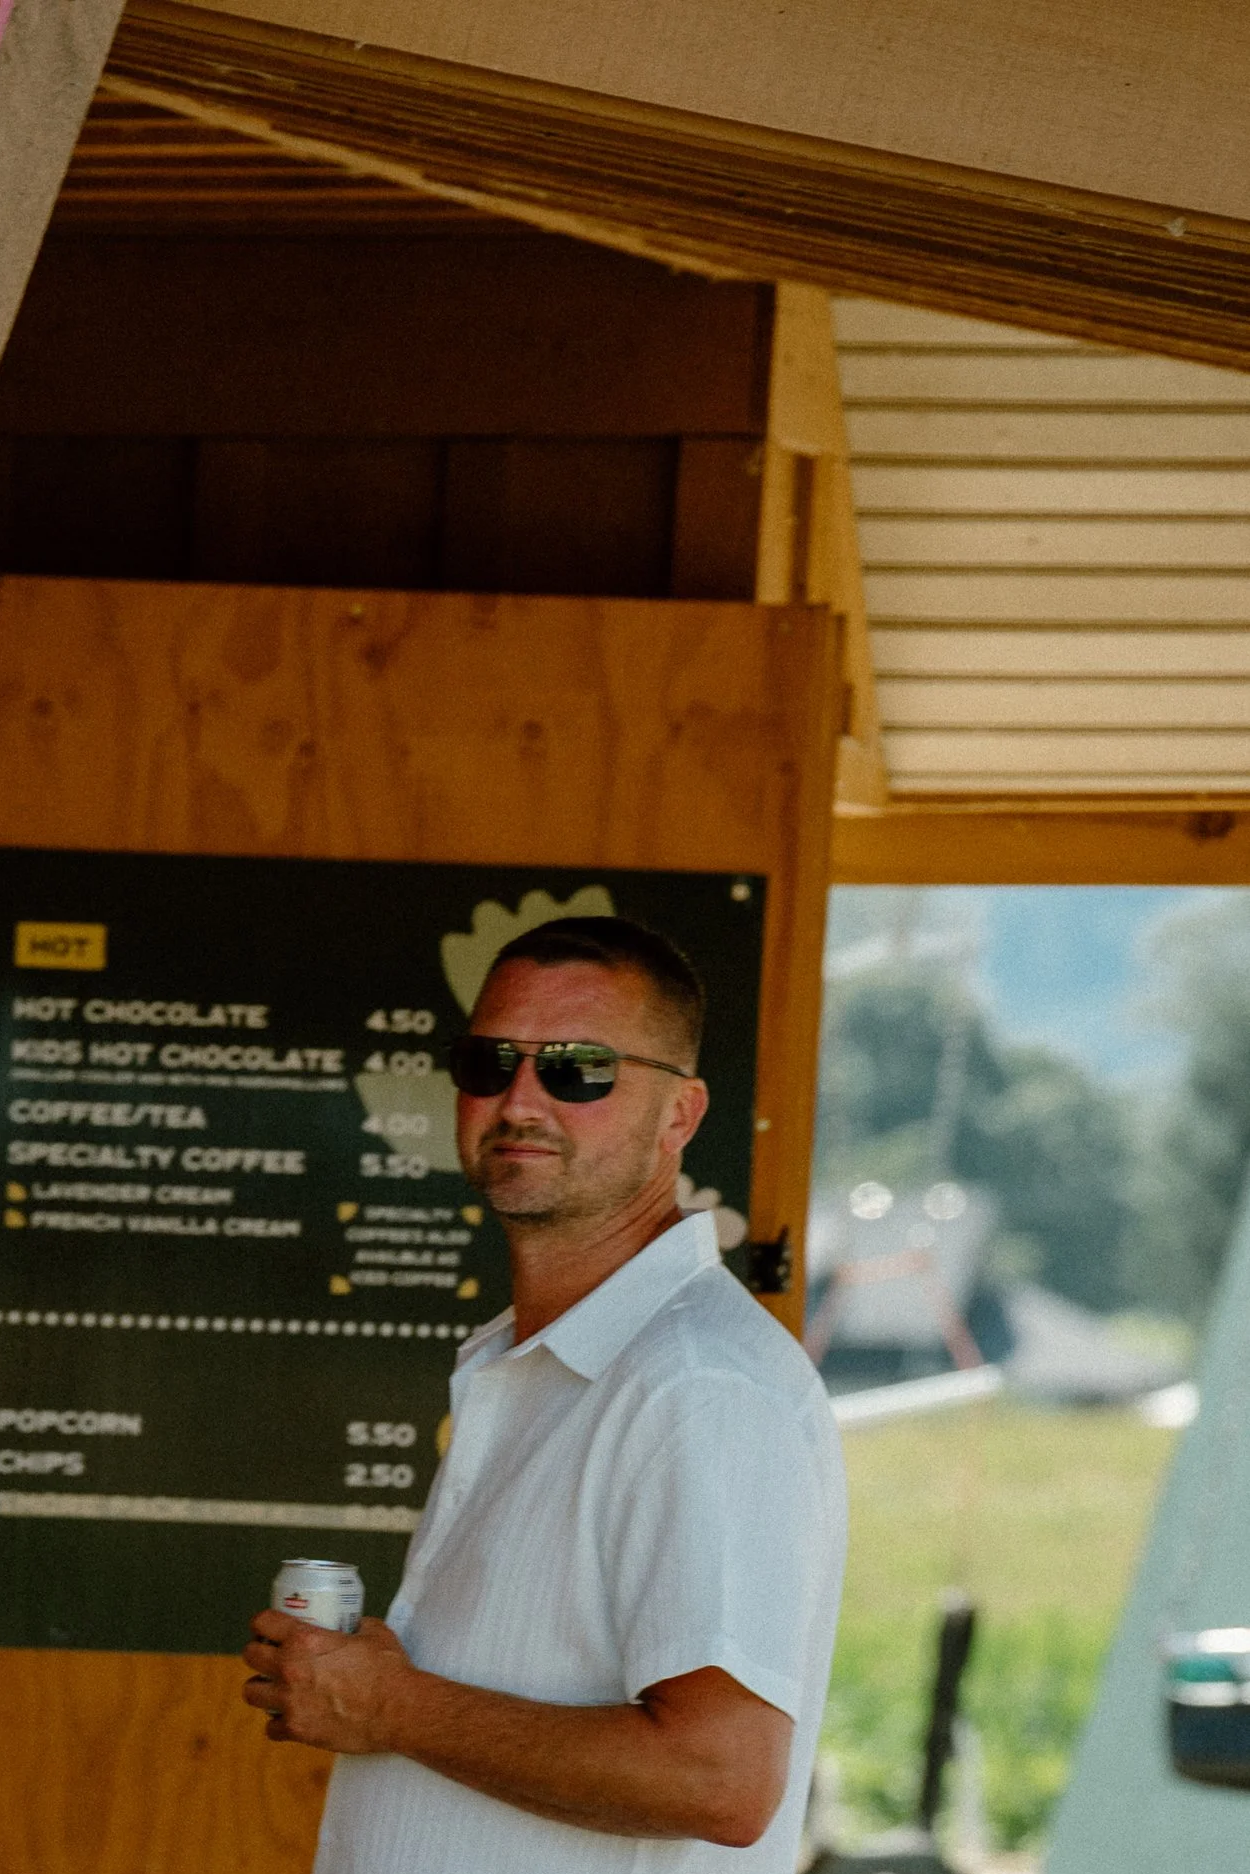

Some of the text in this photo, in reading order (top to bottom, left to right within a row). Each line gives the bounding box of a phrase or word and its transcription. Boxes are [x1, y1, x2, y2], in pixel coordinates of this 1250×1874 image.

[29, 936, 90, 957] HOT
[12, 998, 267, 1028] HOT CHOCOLATE
[10, 1040, 343, 1073] KIDS HOT CHOCOLATE
[8, 1099, 206, 1128] COFFEE/TEA
[8, 1141, 304, 1174] SPECIALTY COFFEE
[33, 1183, 233, 1204] LAVENDER CREAM
[31, 1212, 301, 1236] FRENCH VANILLA CREAM
